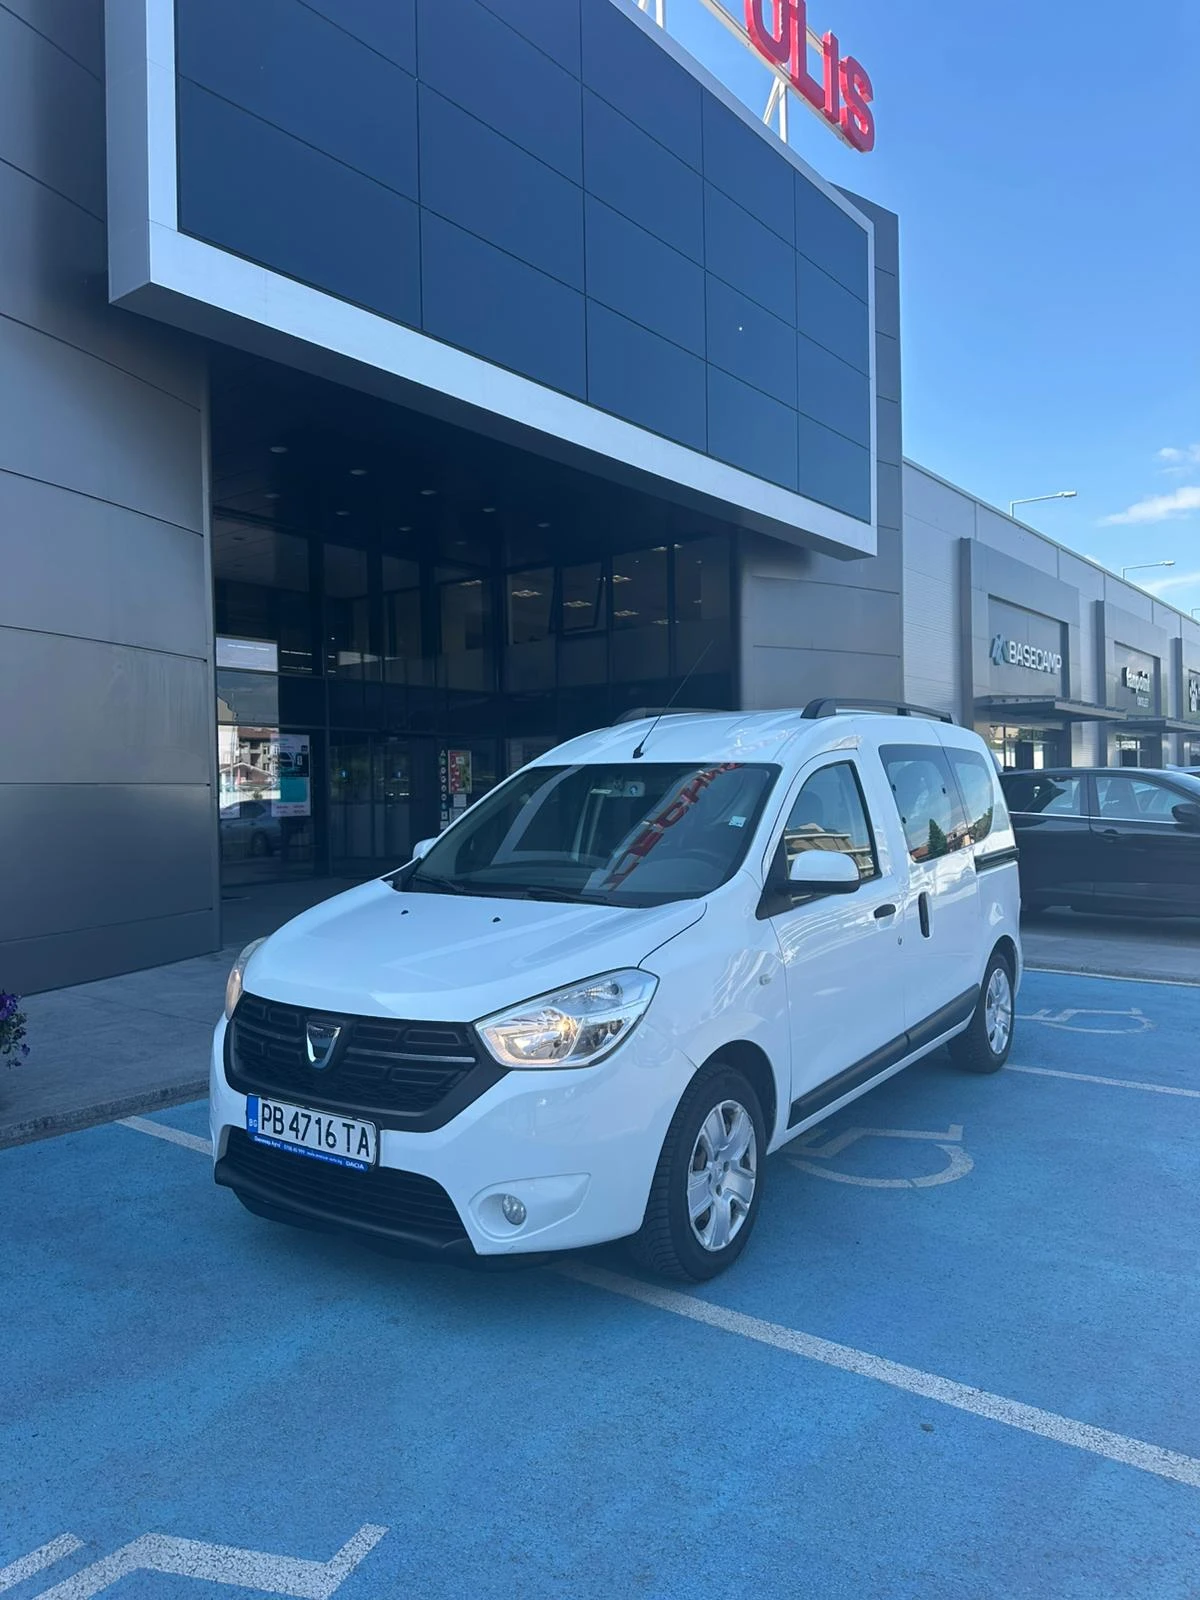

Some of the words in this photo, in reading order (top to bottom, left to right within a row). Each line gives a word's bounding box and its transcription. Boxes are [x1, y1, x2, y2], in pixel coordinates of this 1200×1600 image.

[1009, 640, 1062, 675] BASECAMP
[261, 1102, 285, 1135] PB
[288, 1111, 337, 1149] 4716
[342, 1122, 370, 1158] TA
